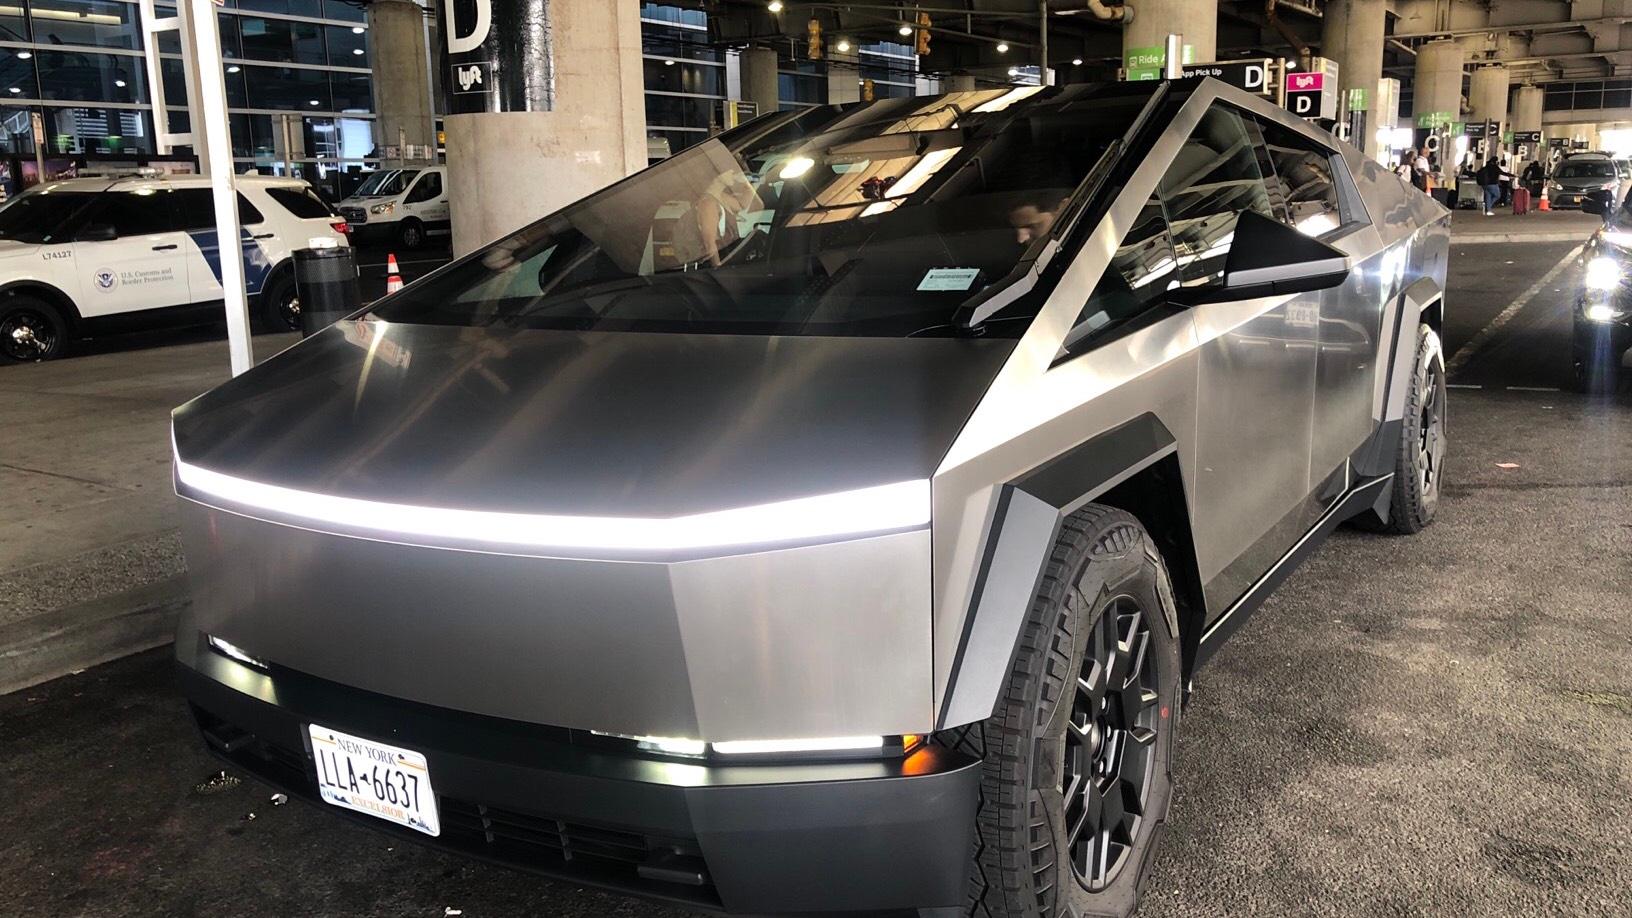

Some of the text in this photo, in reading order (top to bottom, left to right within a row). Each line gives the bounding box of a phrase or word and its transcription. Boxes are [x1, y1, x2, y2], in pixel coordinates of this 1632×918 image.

[444, 0, 491, 53] D
[1138, 55, 1159, 64] Ride
[458, 65, 482, 90] lyft
[1245, 65, 1263, 88] D
[1296, 76, 1314, 88] lyft
[1296, 96, 1311, 113] D
[1531, 133, 1540, 141] C
[144, 275, 173, 283] Protection
[337, 738, 397, 766] NEW YORK
[351, 796, 405, 820] EXCELSIOR
